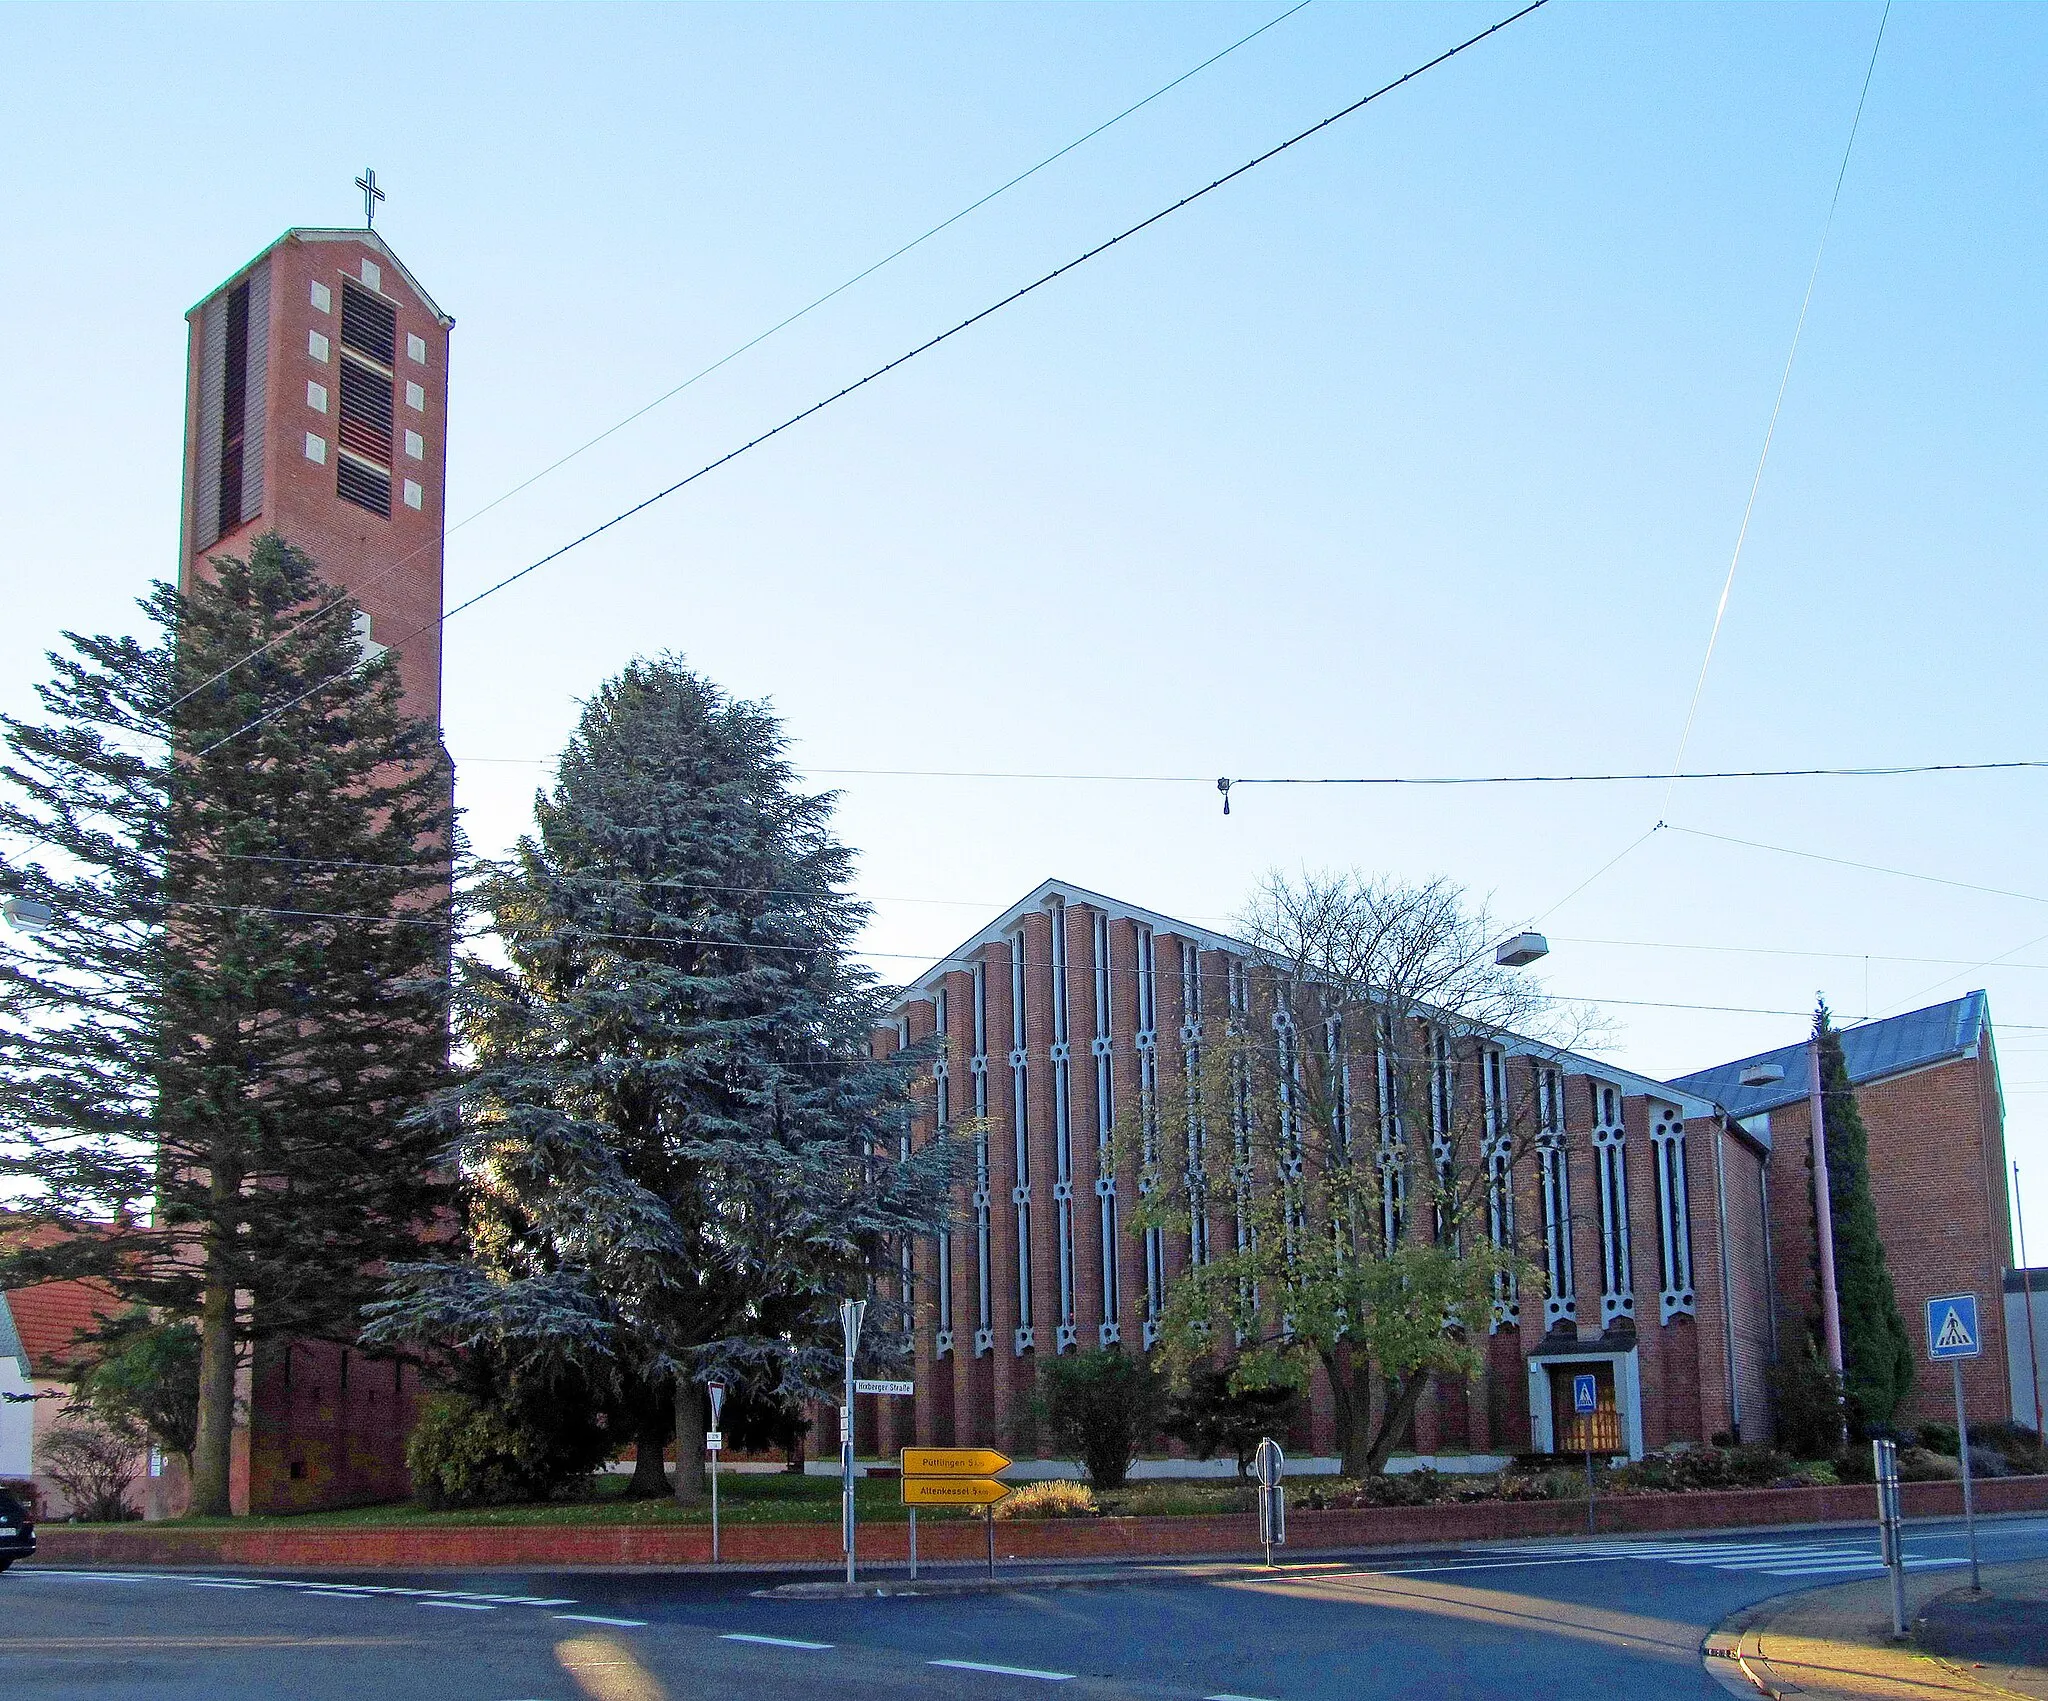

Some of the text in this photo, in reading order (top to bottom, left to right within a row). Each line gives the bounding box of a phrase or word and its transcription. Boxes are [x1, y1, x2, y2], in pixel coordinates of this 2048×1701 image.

[889, 1383, 911, 1392] Straße
[922, 1458, 965, 1468] Püttlingen
[920, 1486, 969, 1496] Altenkessel
